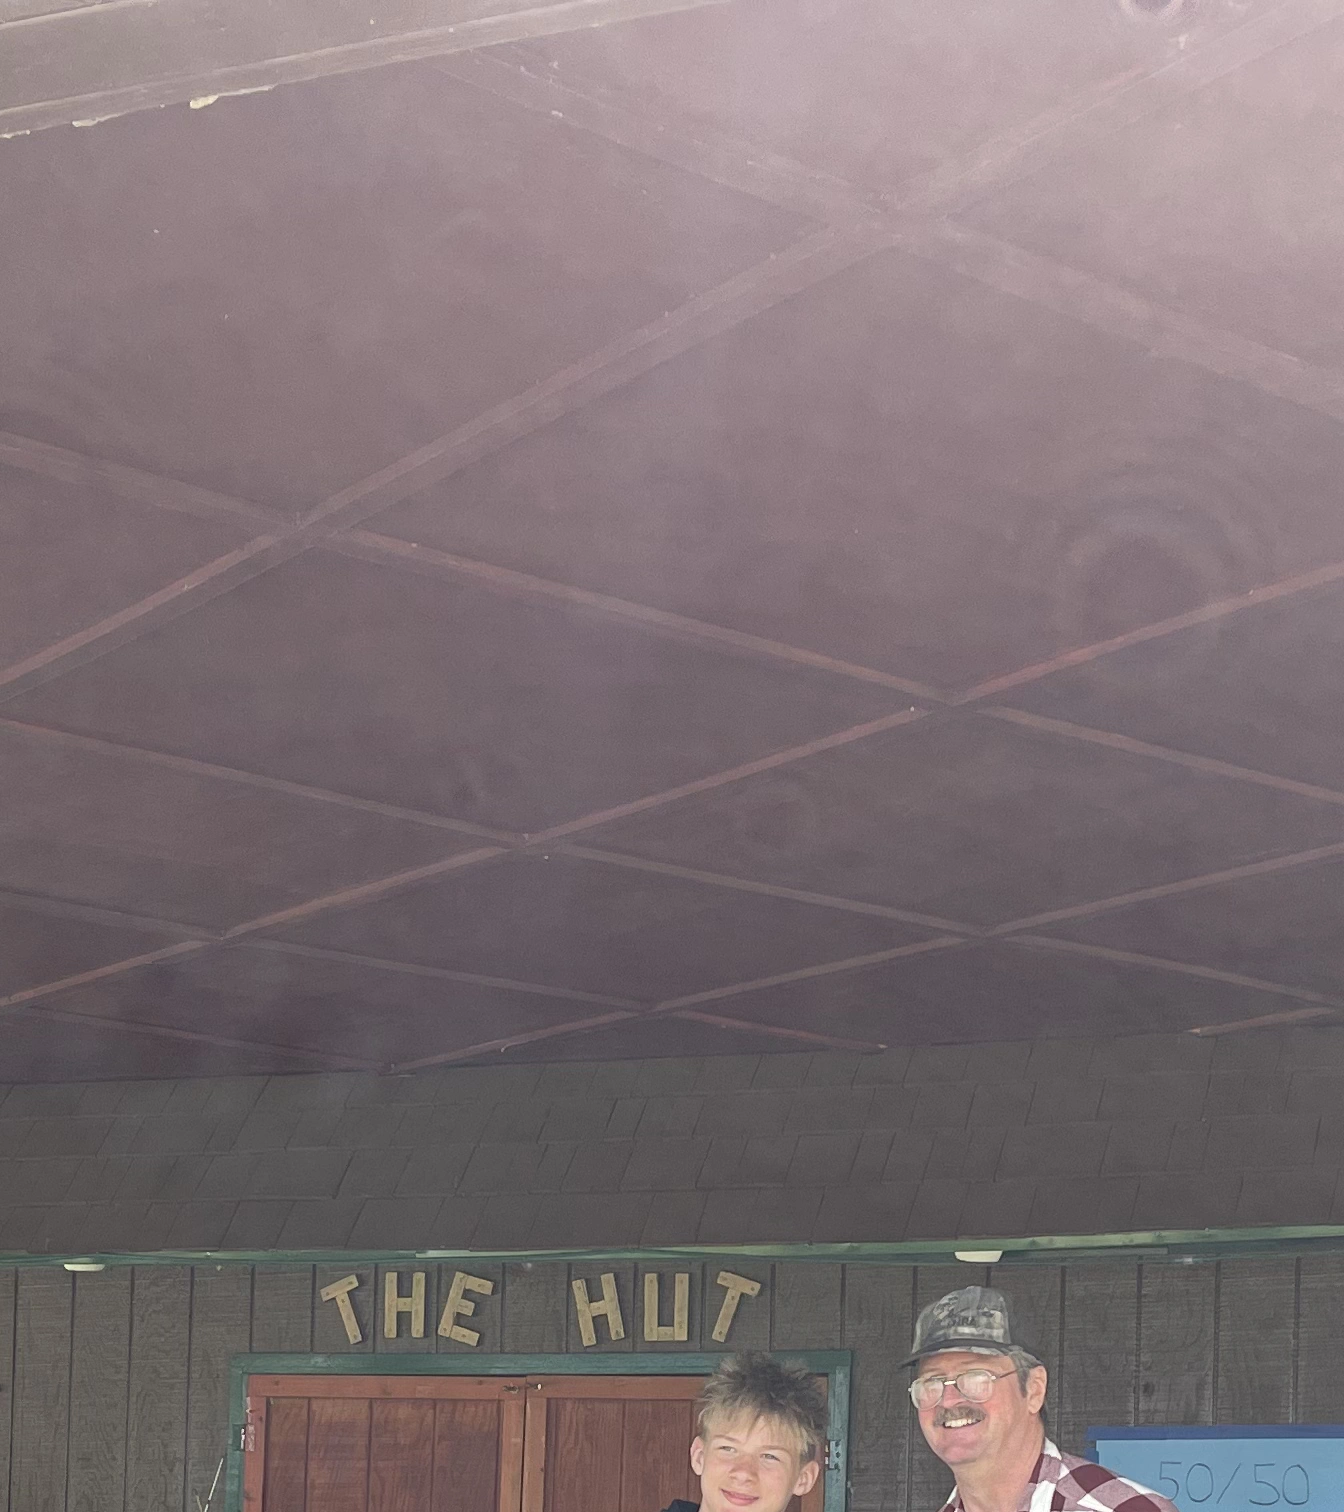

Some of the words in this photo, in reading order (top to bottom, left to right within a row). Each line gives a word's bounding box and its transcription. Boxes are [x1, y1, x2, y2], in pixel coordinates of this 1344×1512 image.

[320, 1271, 494, 1347] THE
[571, 1271, 761, 1347] HUT
[1159, 1461, 1310, 1506] 50/50
